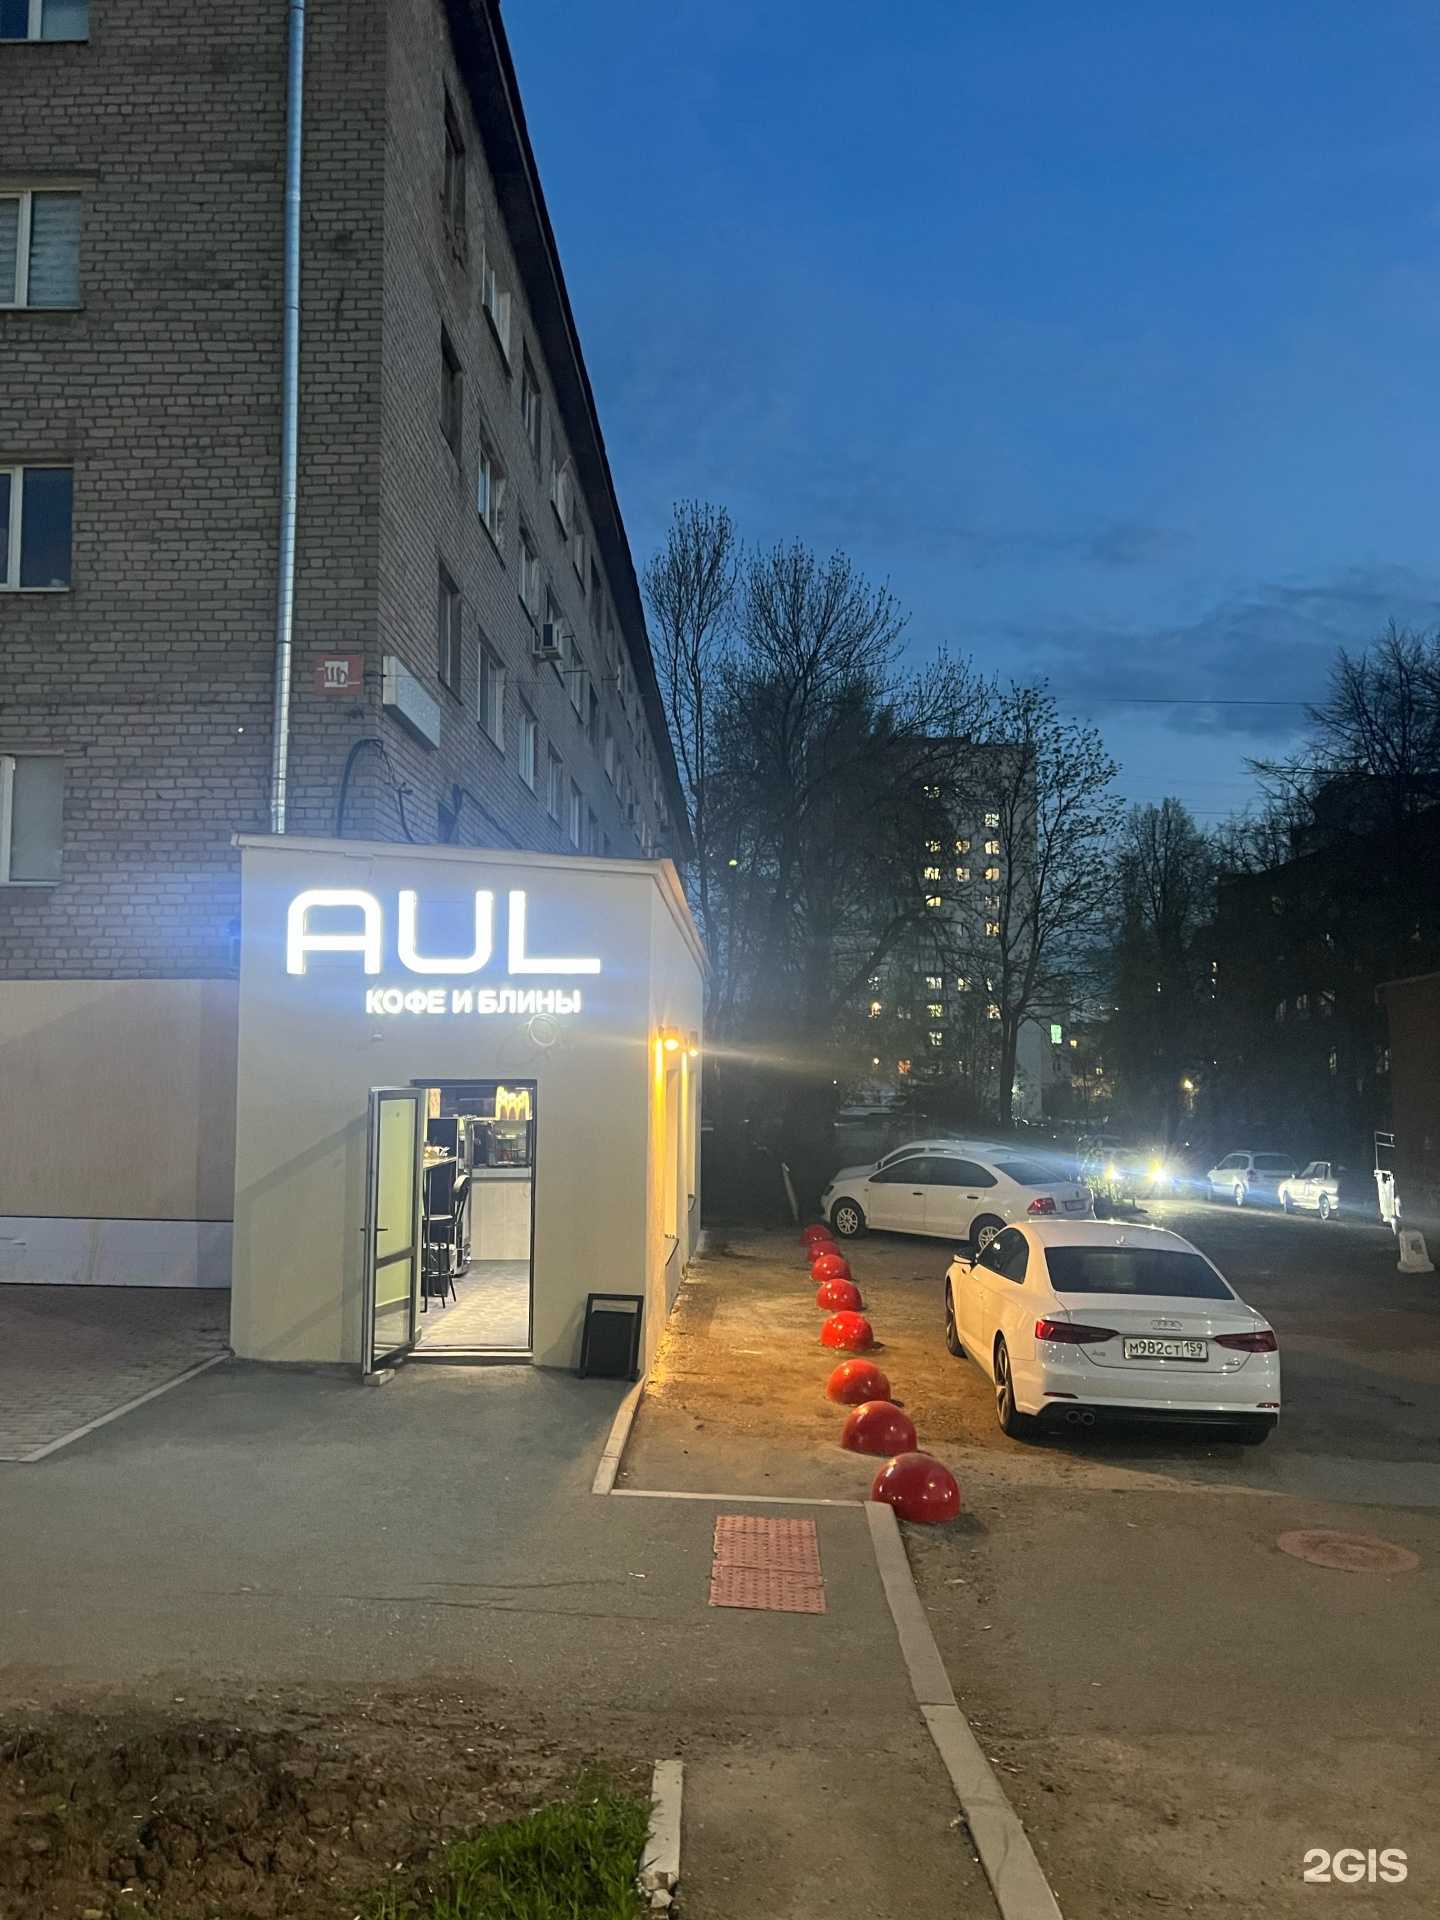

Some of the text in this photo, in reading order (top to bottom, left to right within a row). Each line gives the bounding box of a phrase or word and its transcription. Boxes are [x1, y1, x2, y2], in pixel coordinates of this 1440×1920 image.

[287, 889, 601, 975] AUL
[366, 989, 582, 1014] КОФЕ И БЛИНЫ
